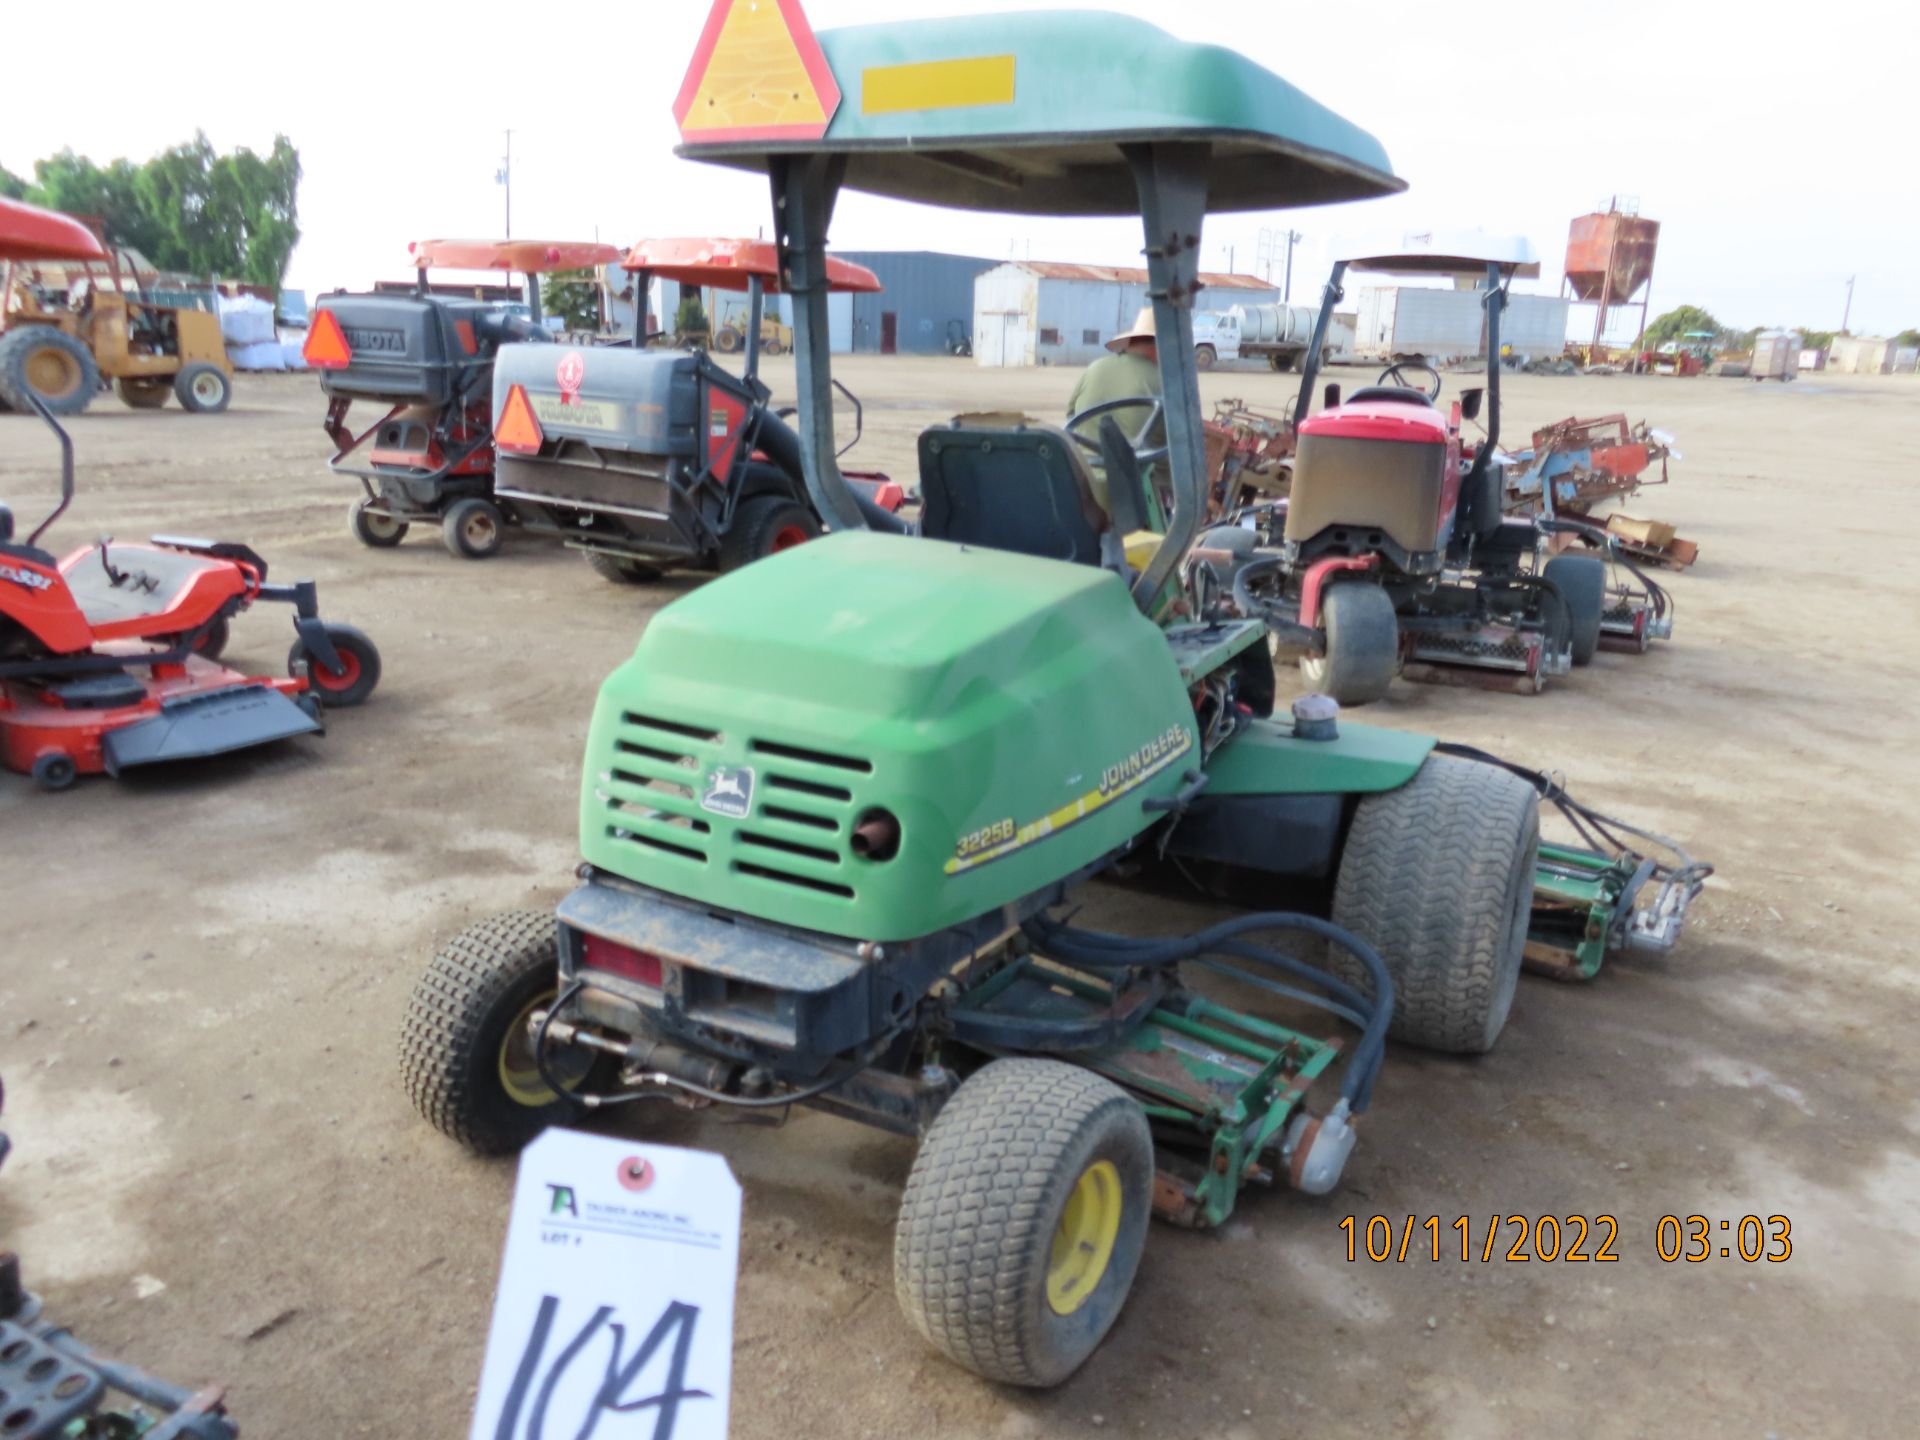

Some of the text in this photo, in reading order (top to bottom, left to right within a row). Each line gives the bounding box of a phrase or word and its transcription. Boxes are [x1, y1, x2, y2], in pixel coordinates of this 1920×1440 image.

[1099, 723, 1185, 796] JOHN DEERE
[957, 817, 1016, 856] 3225B
[494, 1294, 714, 1440] 104
